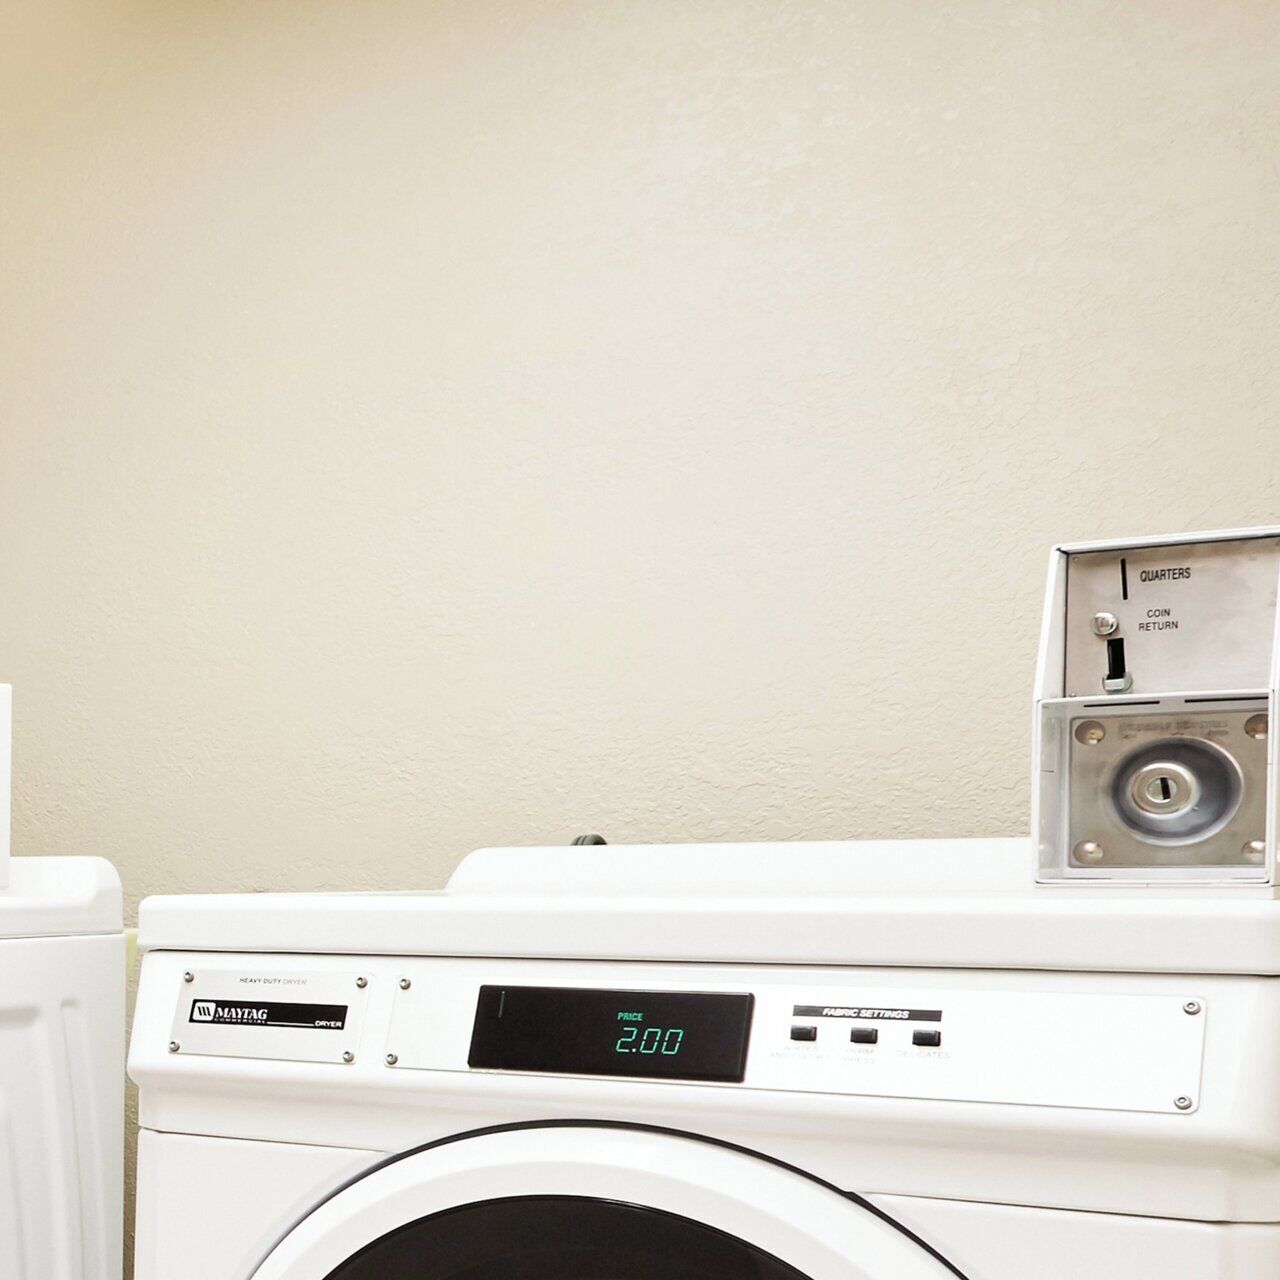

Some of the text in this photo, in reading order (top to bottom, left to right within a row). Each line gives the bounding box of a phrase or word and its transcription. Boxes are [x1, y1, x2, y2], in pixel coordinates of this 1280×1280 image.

[1140, 567, 1191, 582] QUARTERS
[1147, 608, 1171, 619] COIN
[1138, 621, 1179, 631] RETURN
[215, 1007, 268, 1020] MAYTAG
[617, 1012, 644, 1021] PRICE
[822, 1007, 910, 1019] FABRIC SETTINGS
[314, 1020, 342, 1028] DRYER
[616, 1027, 684, 1055] 2.00
